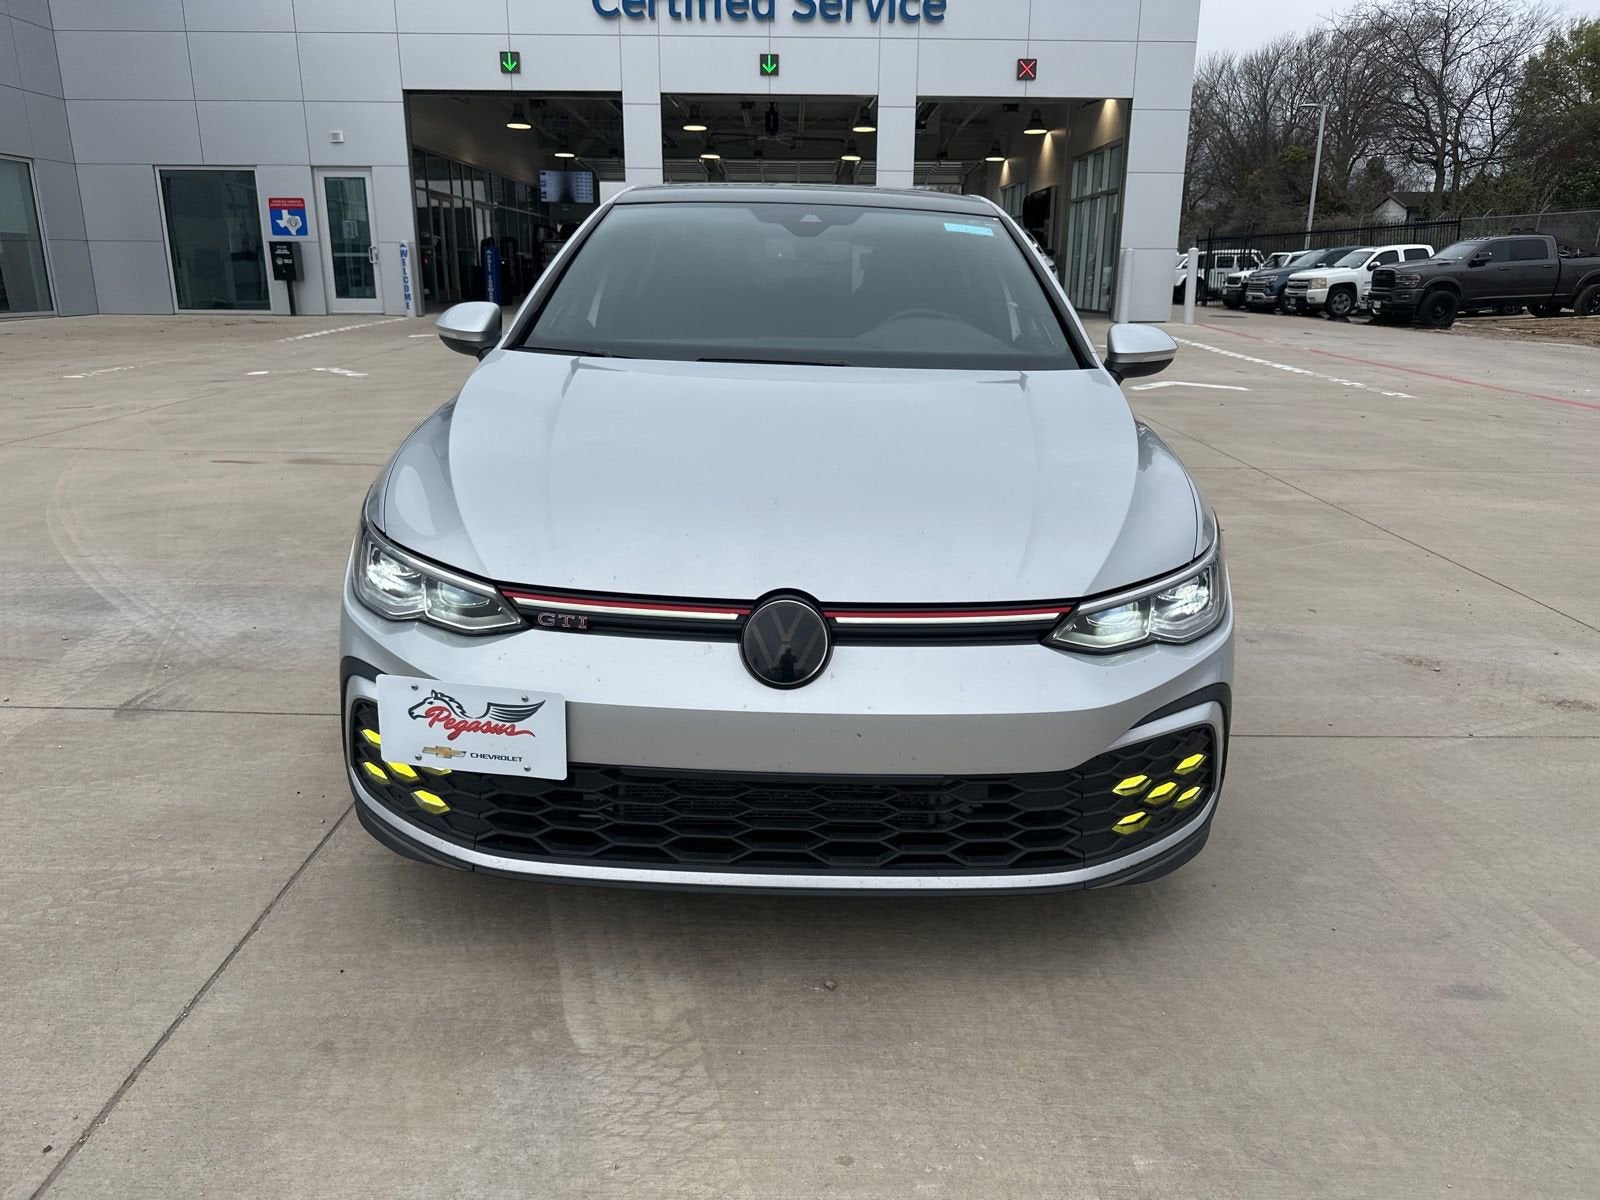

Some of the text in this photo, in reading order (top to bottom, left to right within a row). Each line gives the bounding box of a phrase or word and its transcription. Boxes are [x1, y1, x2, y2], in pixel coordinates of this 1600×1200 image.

[400, 249, 411, 310] WELCOME
[538, 612, 588, 629] GTI
[425, 706, 535, 741] Pegasus
[470, 752, 523, 762] CHEVROLET
